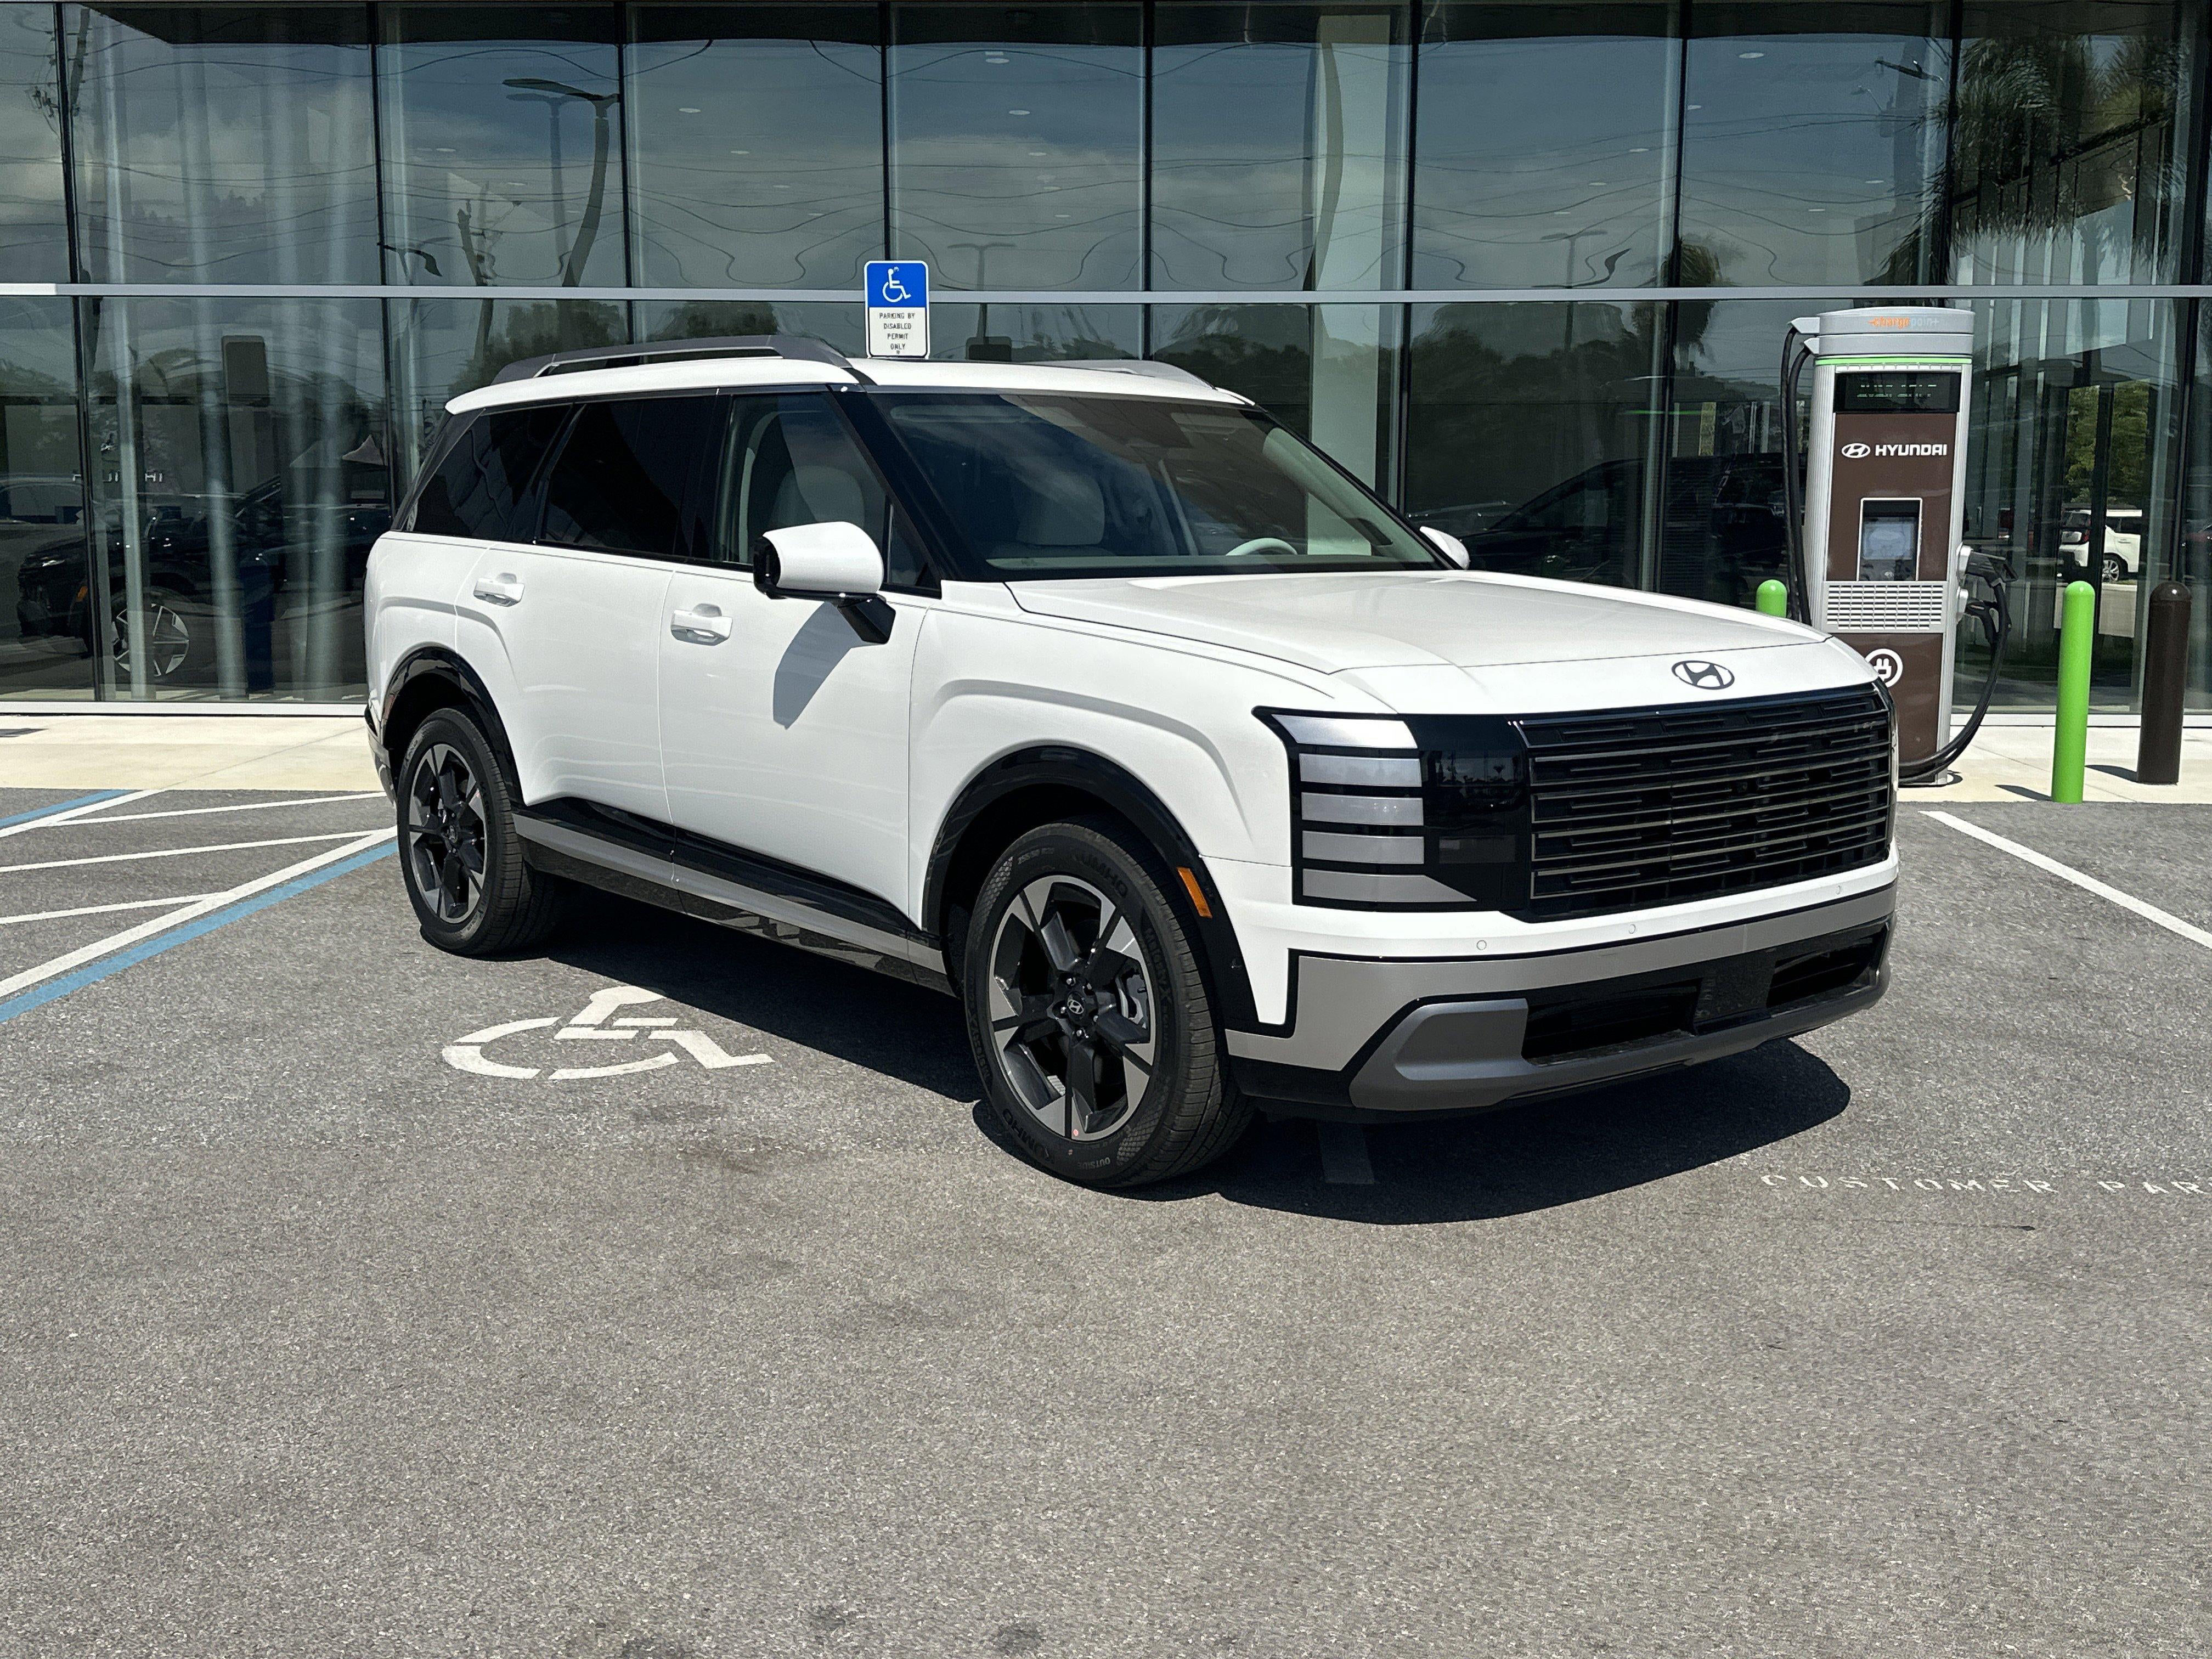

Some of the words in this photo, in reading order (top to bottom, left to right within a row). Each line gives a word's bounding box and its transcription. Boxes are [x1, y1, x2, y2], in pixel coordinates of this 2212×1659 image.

[1875, 443, 1947, 456] HYUNDAI
[1760, 1174, 2059, 1194] CUSTOMER
[2097, 1179, 2212, 1194] PAR
